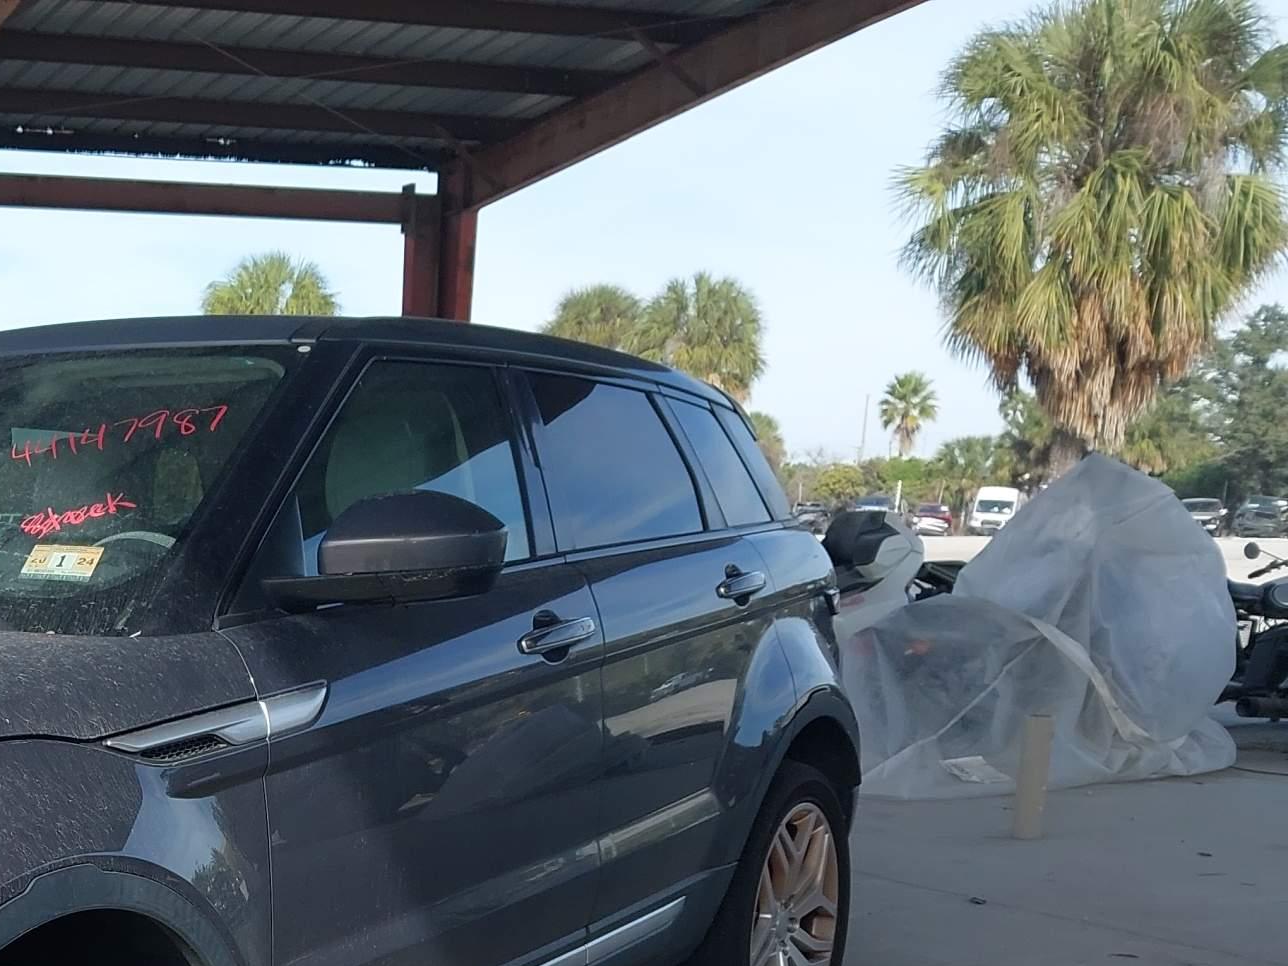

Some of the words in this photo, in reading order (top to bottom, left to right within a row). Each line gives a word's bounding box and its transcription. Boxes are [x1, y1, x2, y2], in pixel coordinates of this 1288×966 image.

[11, 404, 228, 468] 44147987
[55, 554, 65, 568] 1
[76, 557, 95, 567] 24
